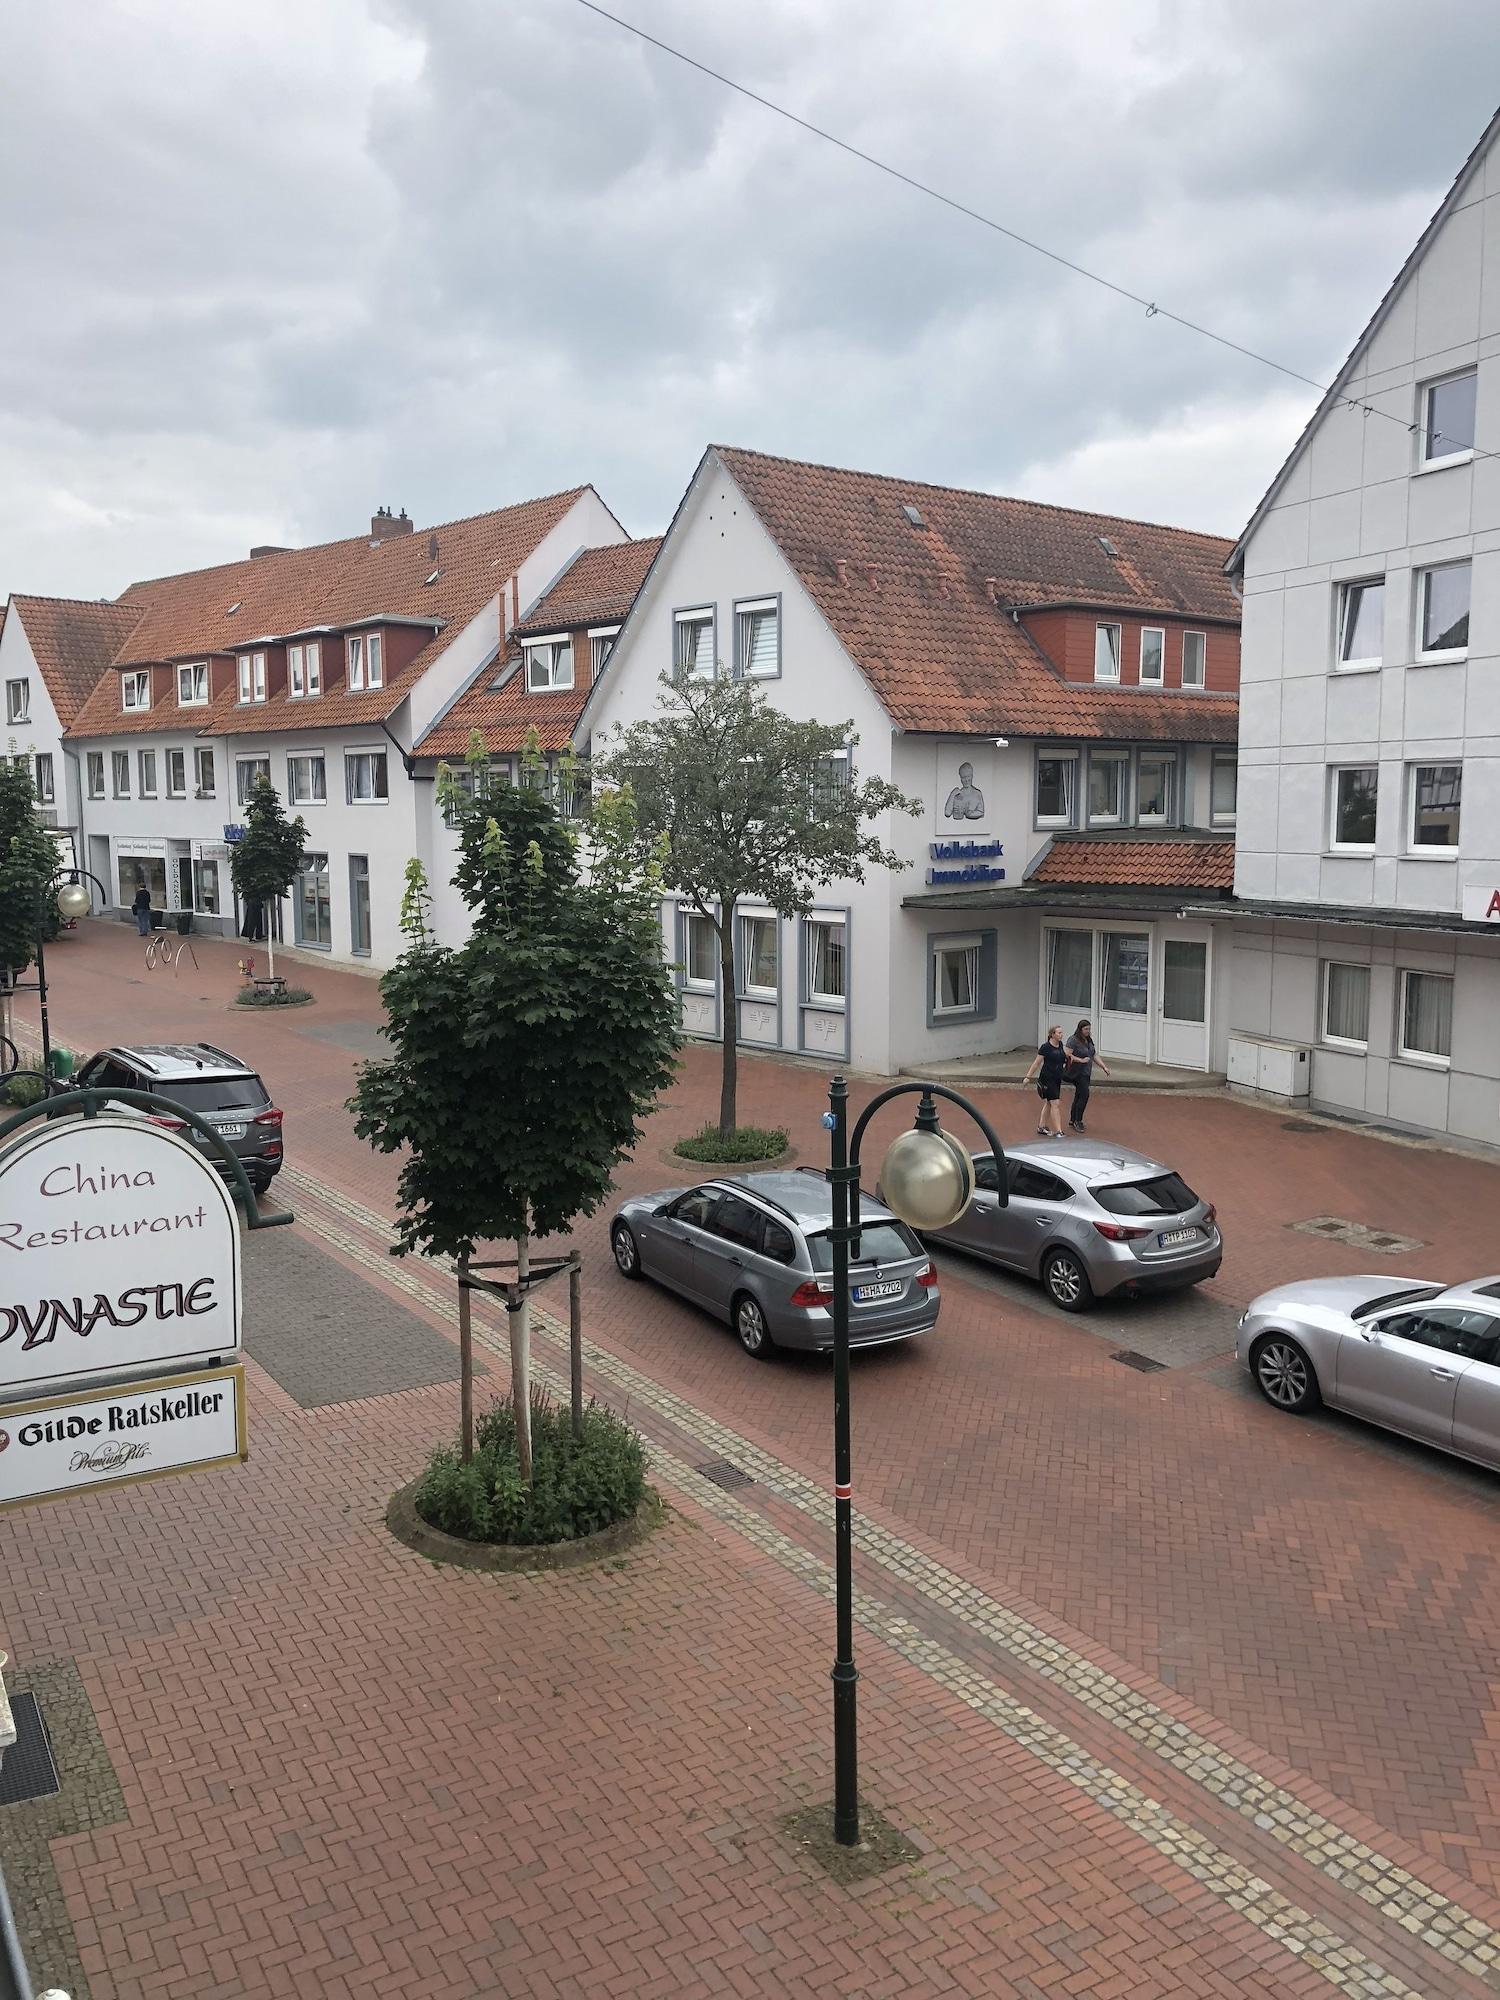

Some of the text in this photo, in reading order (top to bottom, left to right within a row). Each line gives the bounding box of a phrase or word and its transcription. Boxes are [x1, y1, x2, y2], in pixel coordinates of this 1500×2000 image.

[929, 840, 1004, 859] Volksbank
[40, 1163, 155, 1197] China
[0, 1206, 207, 1251] Restaurant
[18, 1392, 224, 1447] Gilde Ratskeller
[69, 1441, 153, 1472] Premium Pils
